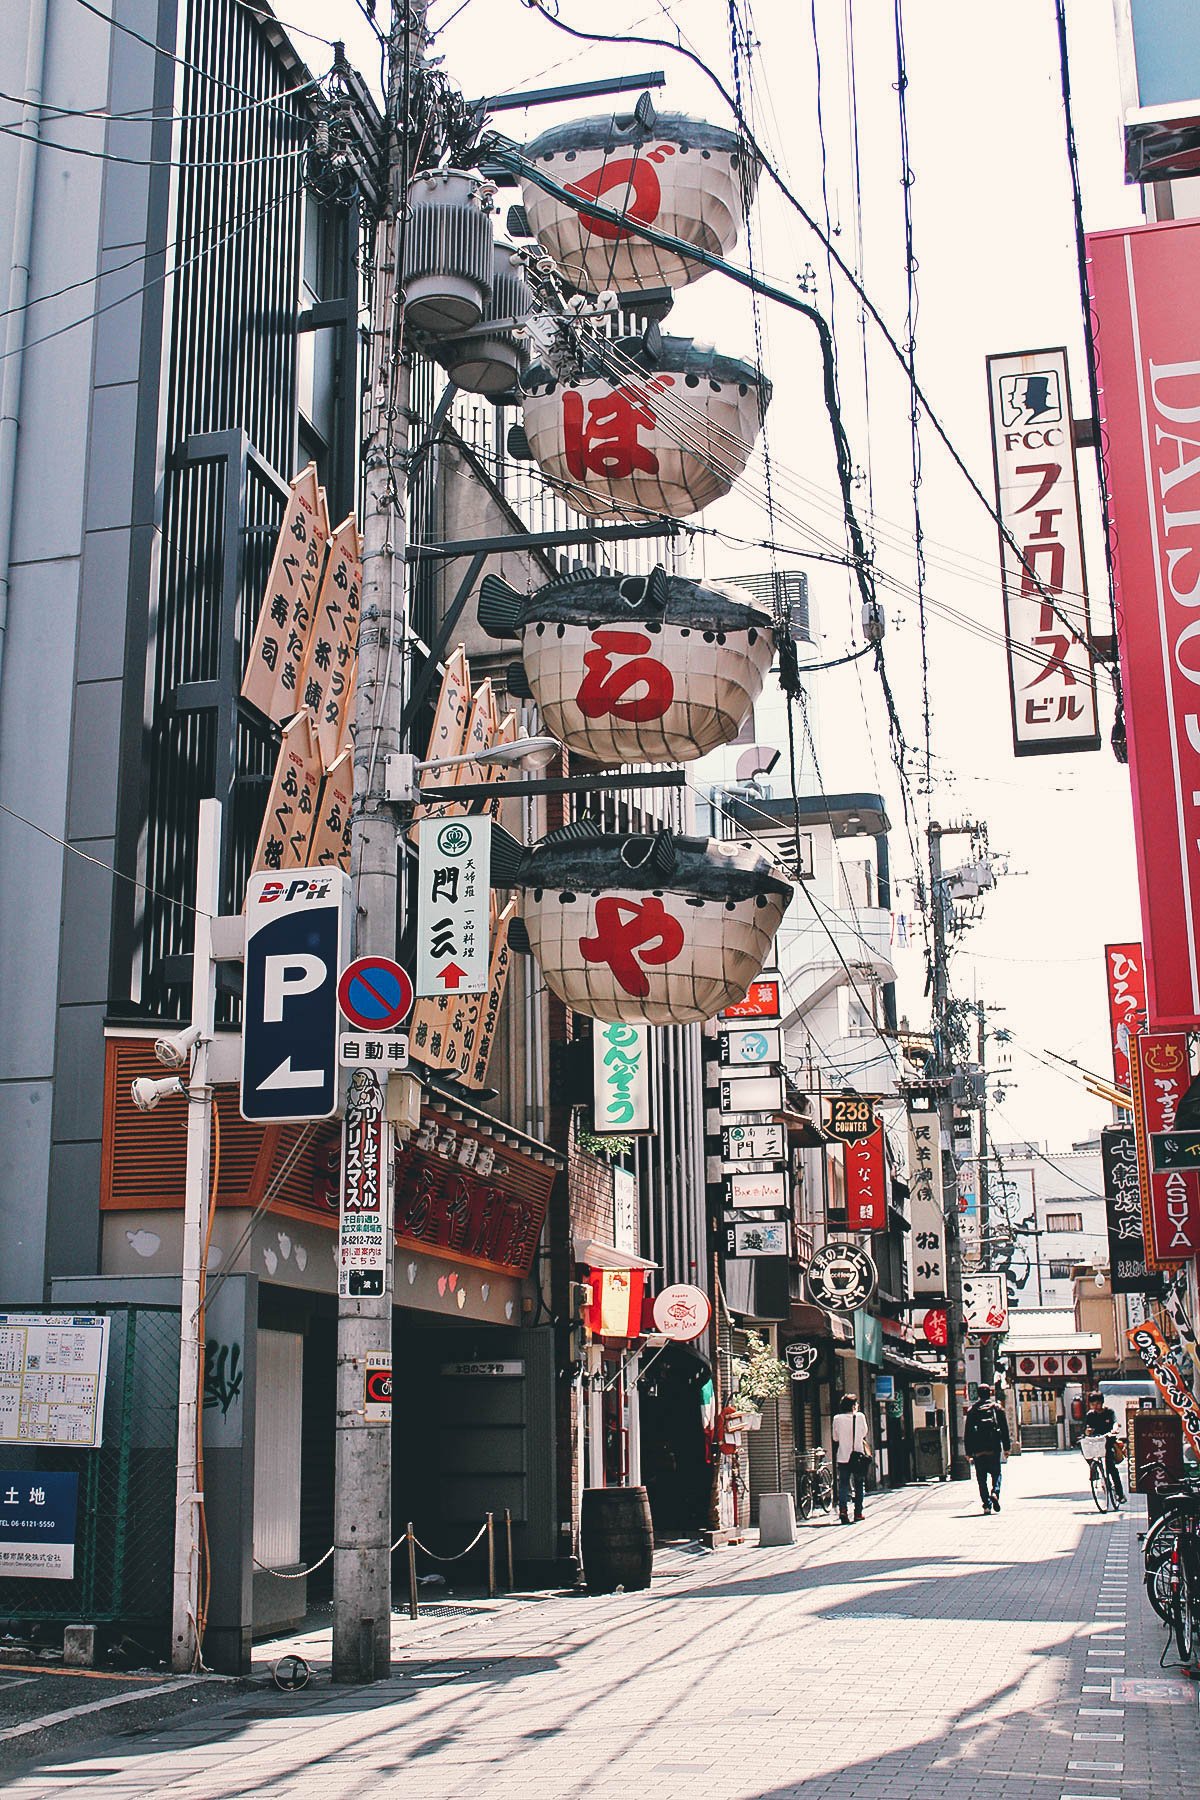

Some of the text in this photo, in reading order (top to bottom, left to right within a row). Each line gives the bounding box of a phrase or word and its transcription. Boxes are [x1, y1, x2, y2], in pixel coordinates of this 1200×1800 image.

[562, 374, 676, 481] ぼ
[1005, 429, 1064, 452] FCC
[1008, 463, 1080, 691] フェローズ
[576, 631, 674, 722] ら
[1025, 696, 1085, 725] ビル
[578, 897, 685, 997] や
[263, 953, 328, 1022] P
[344, 1041, 406, 1060] 自動車
[835, 1102, 870, 1121] 238
[835, 1121, 867, 1132] COUNTER
[346, 1109, 362, 1208] クリスマス
[363, 1109, 378, 1207] リトルチャペル
[737, 1140, 780, 1157] 門三
[1165, 1172, 1191, 1247] ASUYA
[350, 1257, 376, 1265] こちら
[810, 1246, 868, 1280] 世界のコーヒー
[816, 1285, 866, 1308] アラビヤ
[3, 1486, 46, 1505] 土地
